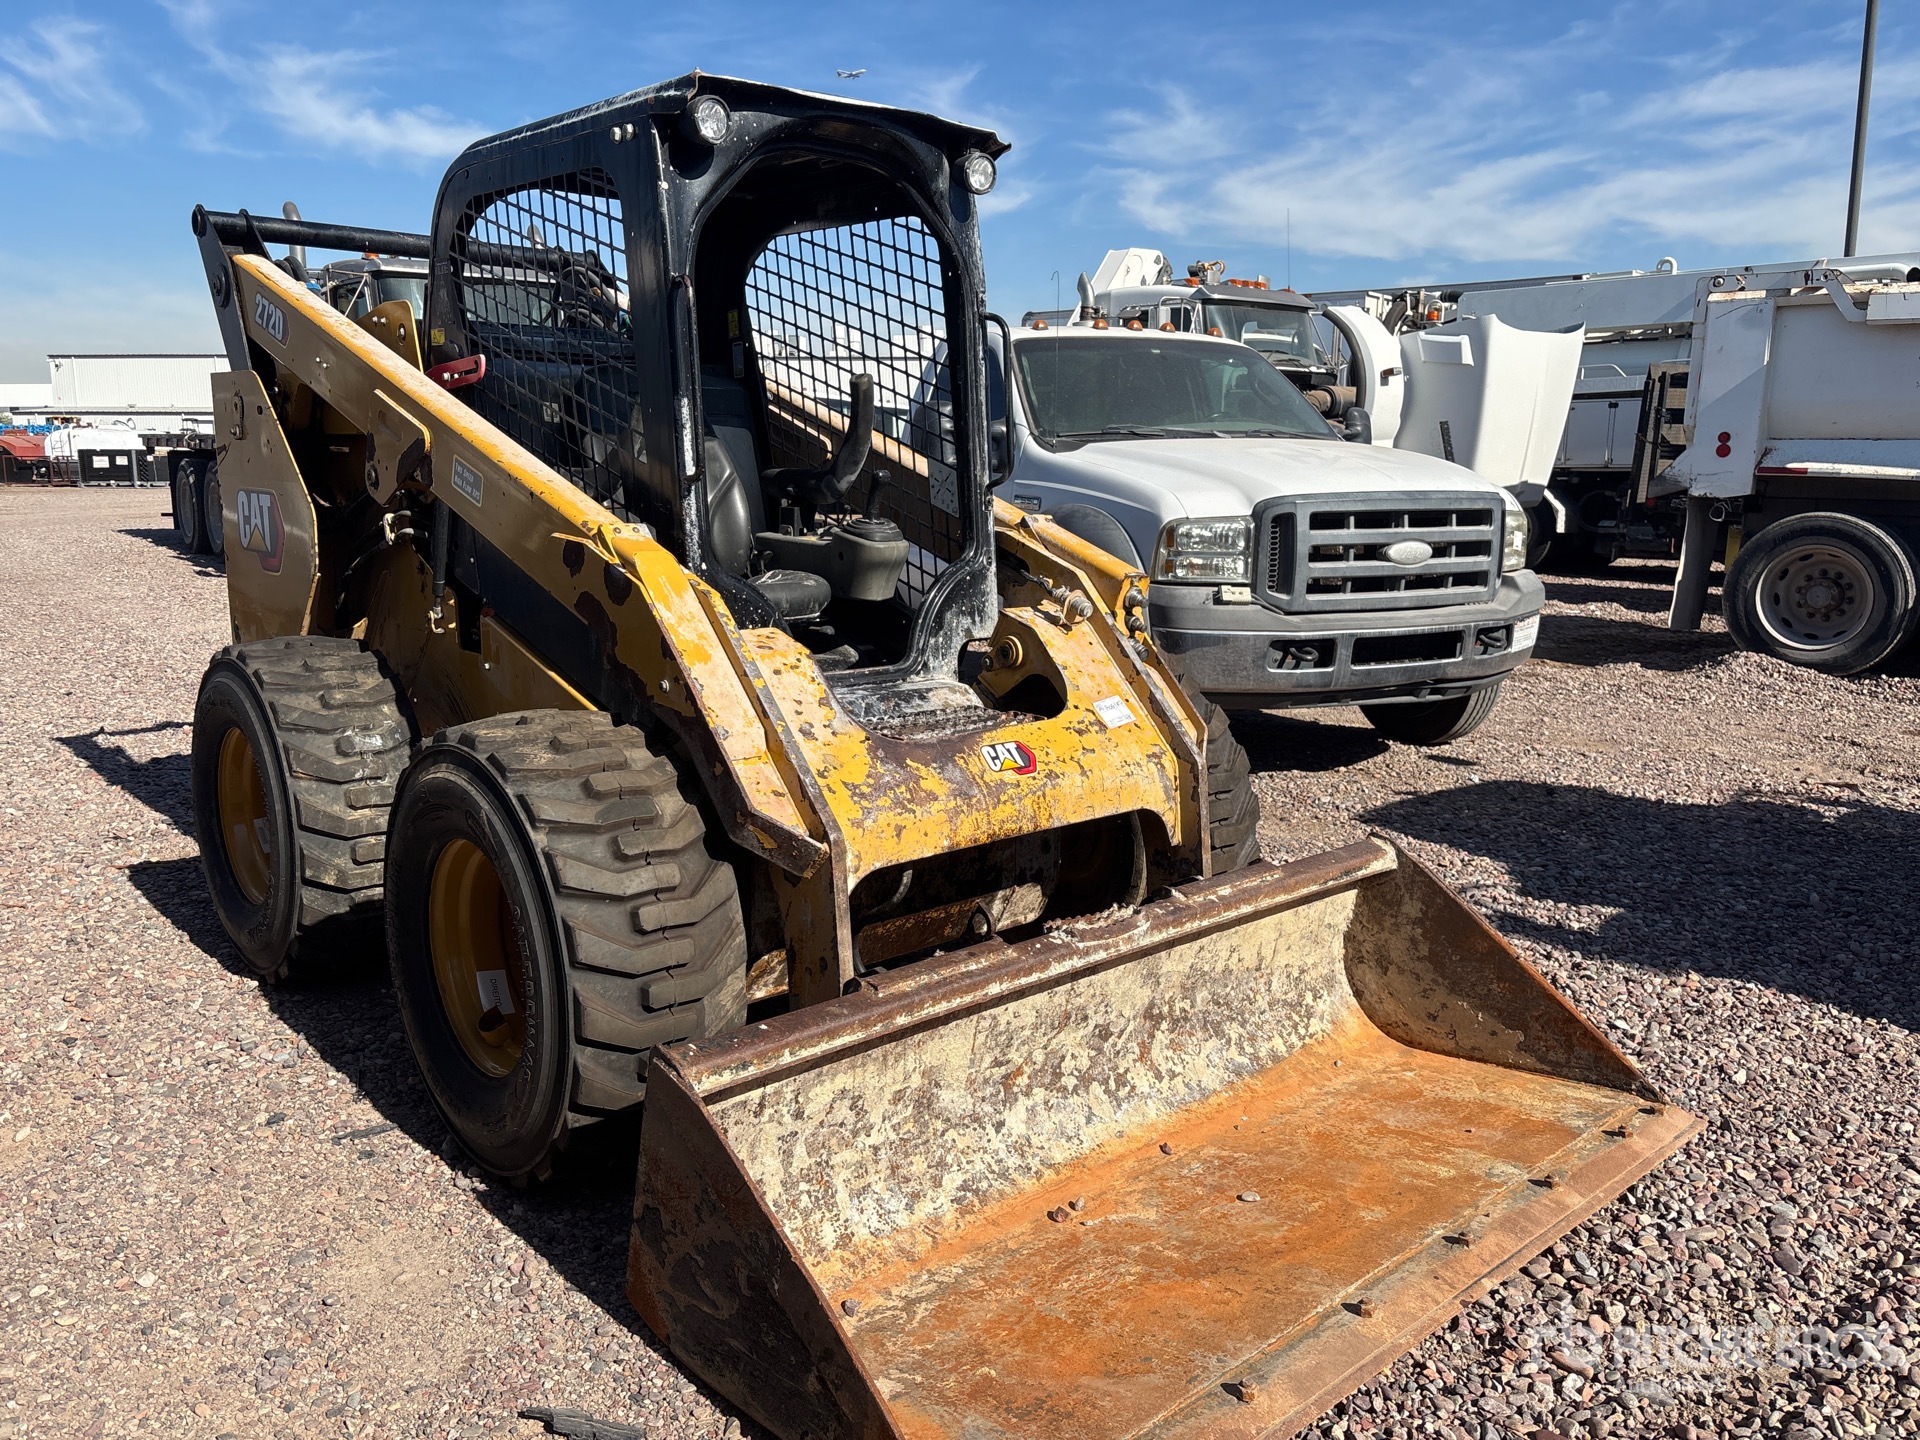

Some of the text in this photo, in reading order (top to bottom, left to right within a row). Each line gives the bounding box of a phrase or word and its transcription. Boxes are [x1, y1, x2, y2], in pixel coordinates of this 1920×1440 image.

[255, 292, 284, 341] 272D
[237, 490, 272, 553] CAT
[981, 741, 1025, 772] CAT
[490, 978, 503, 1007] DIREITO
